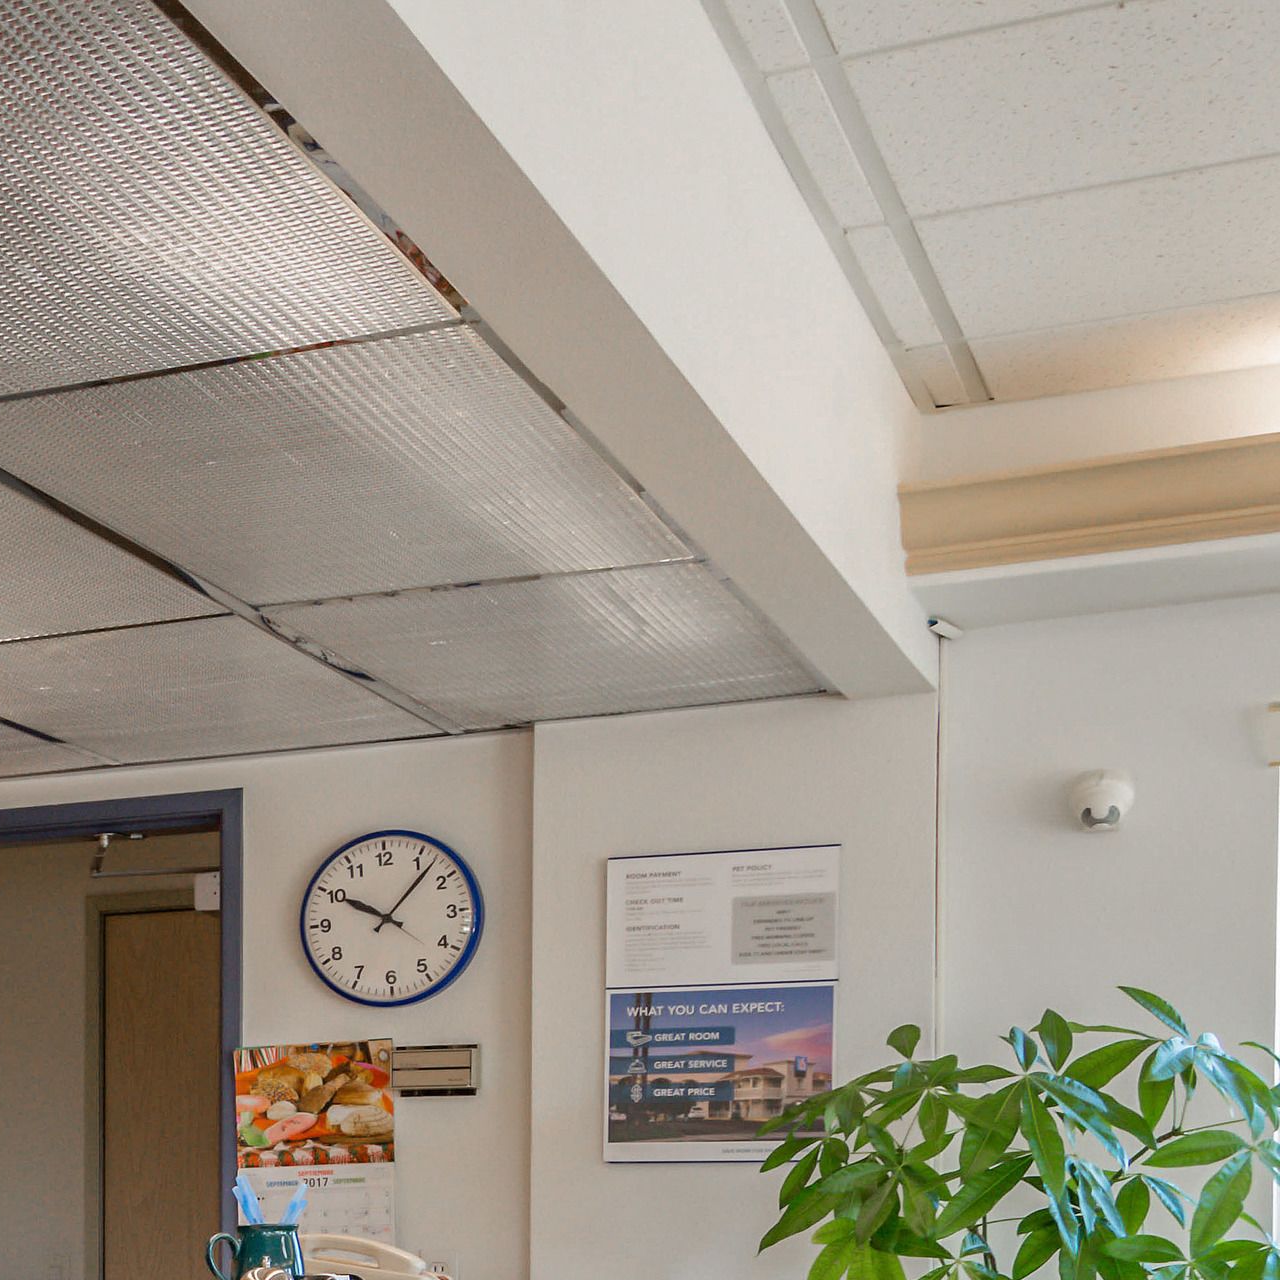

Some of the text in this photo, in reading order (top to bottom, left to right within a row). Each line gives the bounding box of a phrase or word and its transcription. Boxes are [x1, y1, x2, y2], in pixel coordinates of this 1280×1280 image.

[375, 851, 394, 867] 12
[412, 856, 421, 871] 1
[346, 863, 364, 879] 11
[648, 871, 682, 879] PAYMENT
[435, 875, 447, 890] 2
[326, 888, 346, 904] 10
[446, 904, 458, 919] 3
[319, 918, 332, 933] 9
[437, 935, 449, 949] 4
[331, 946, 343, 961] 8
[354, 965, 365, 980] 7
[416, 958, 428, 973] 5
[385, 970, 397, 985] 6
[626, 1001, 785, 1017] WHAT YOU CAN EXPECT:
[654, 1032, 720, 1042] GREAT ROOM
[653, 1059, 728, 1070] GREAT SERVICE
[653, 1087, 715, 1097] GREAT PRICE
[303, 1177, 329, 1188] 2017
